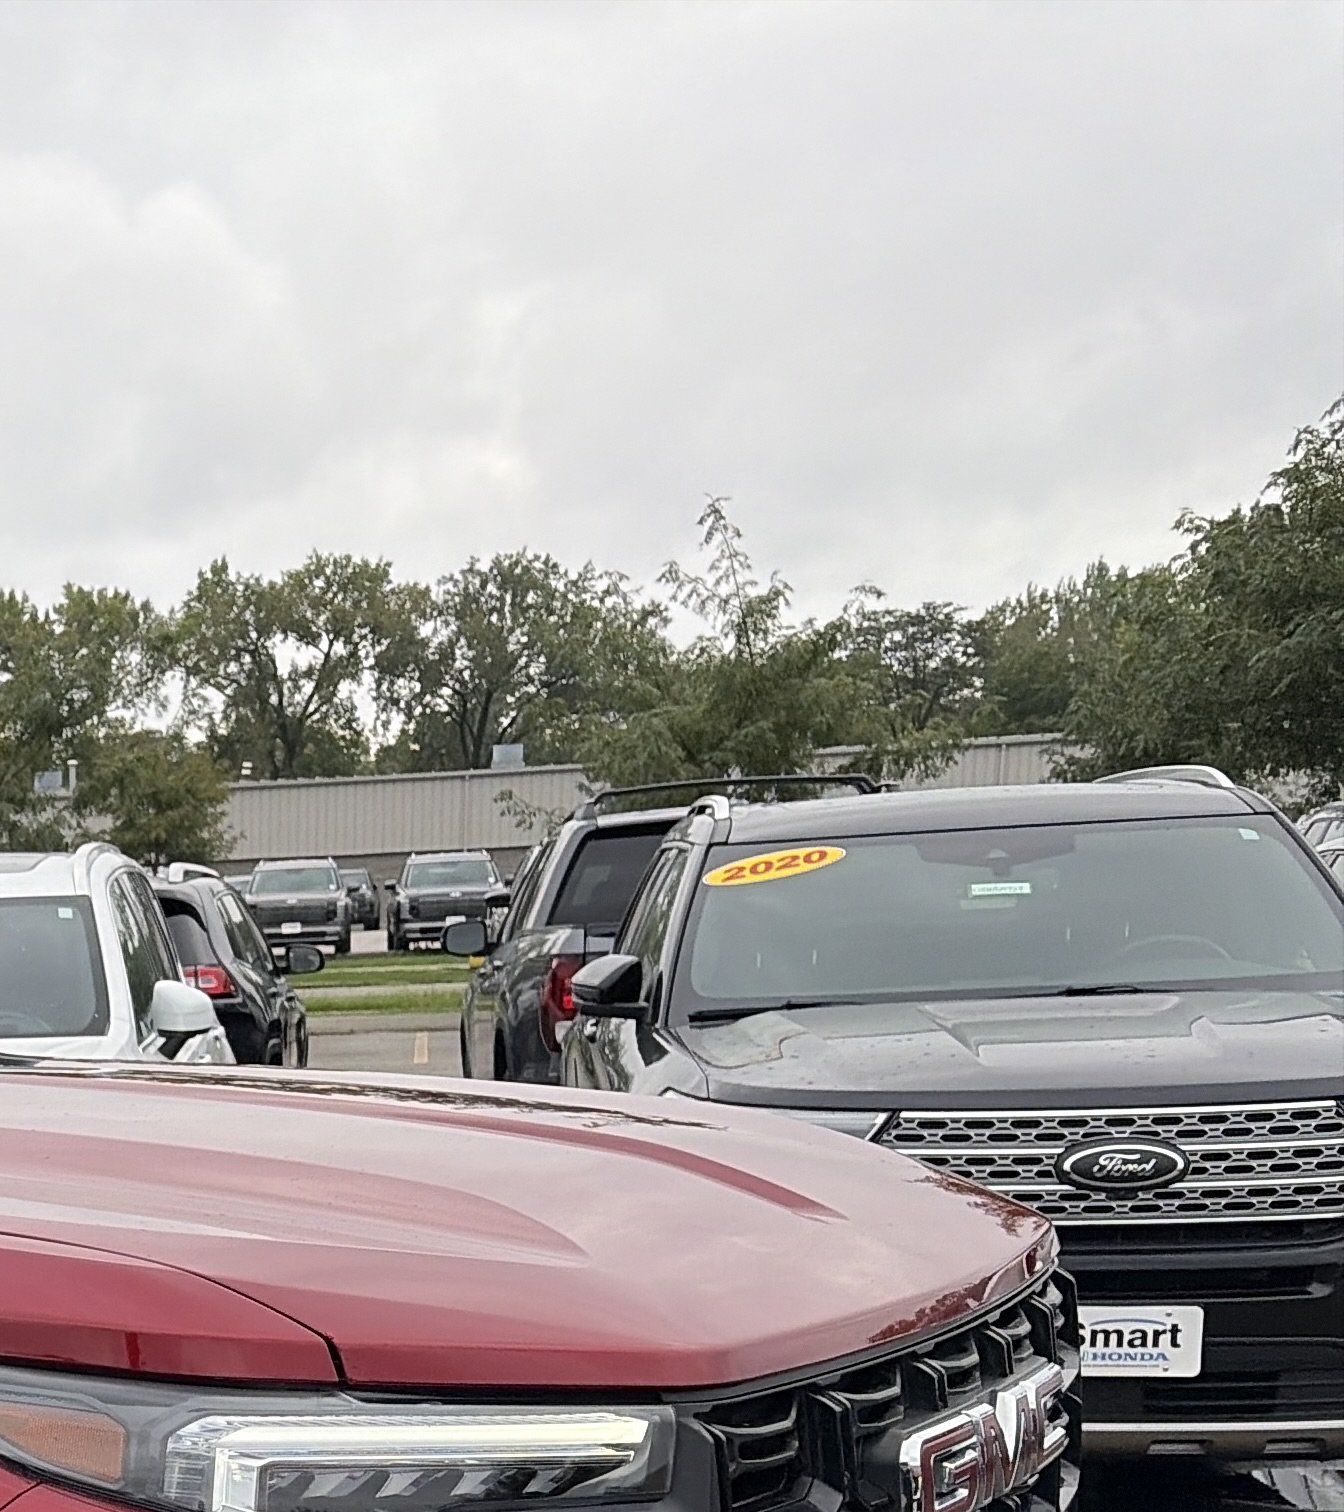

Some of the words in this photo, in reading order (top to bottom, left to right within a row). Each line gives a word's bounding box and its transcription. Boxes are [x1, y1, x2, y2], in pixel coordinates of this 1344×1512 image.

[720, 849, 828, 883] 2020
[1092, 1153, 1157, 1178] Ford
[1092, 1352, 1169, 1362] HONDA
